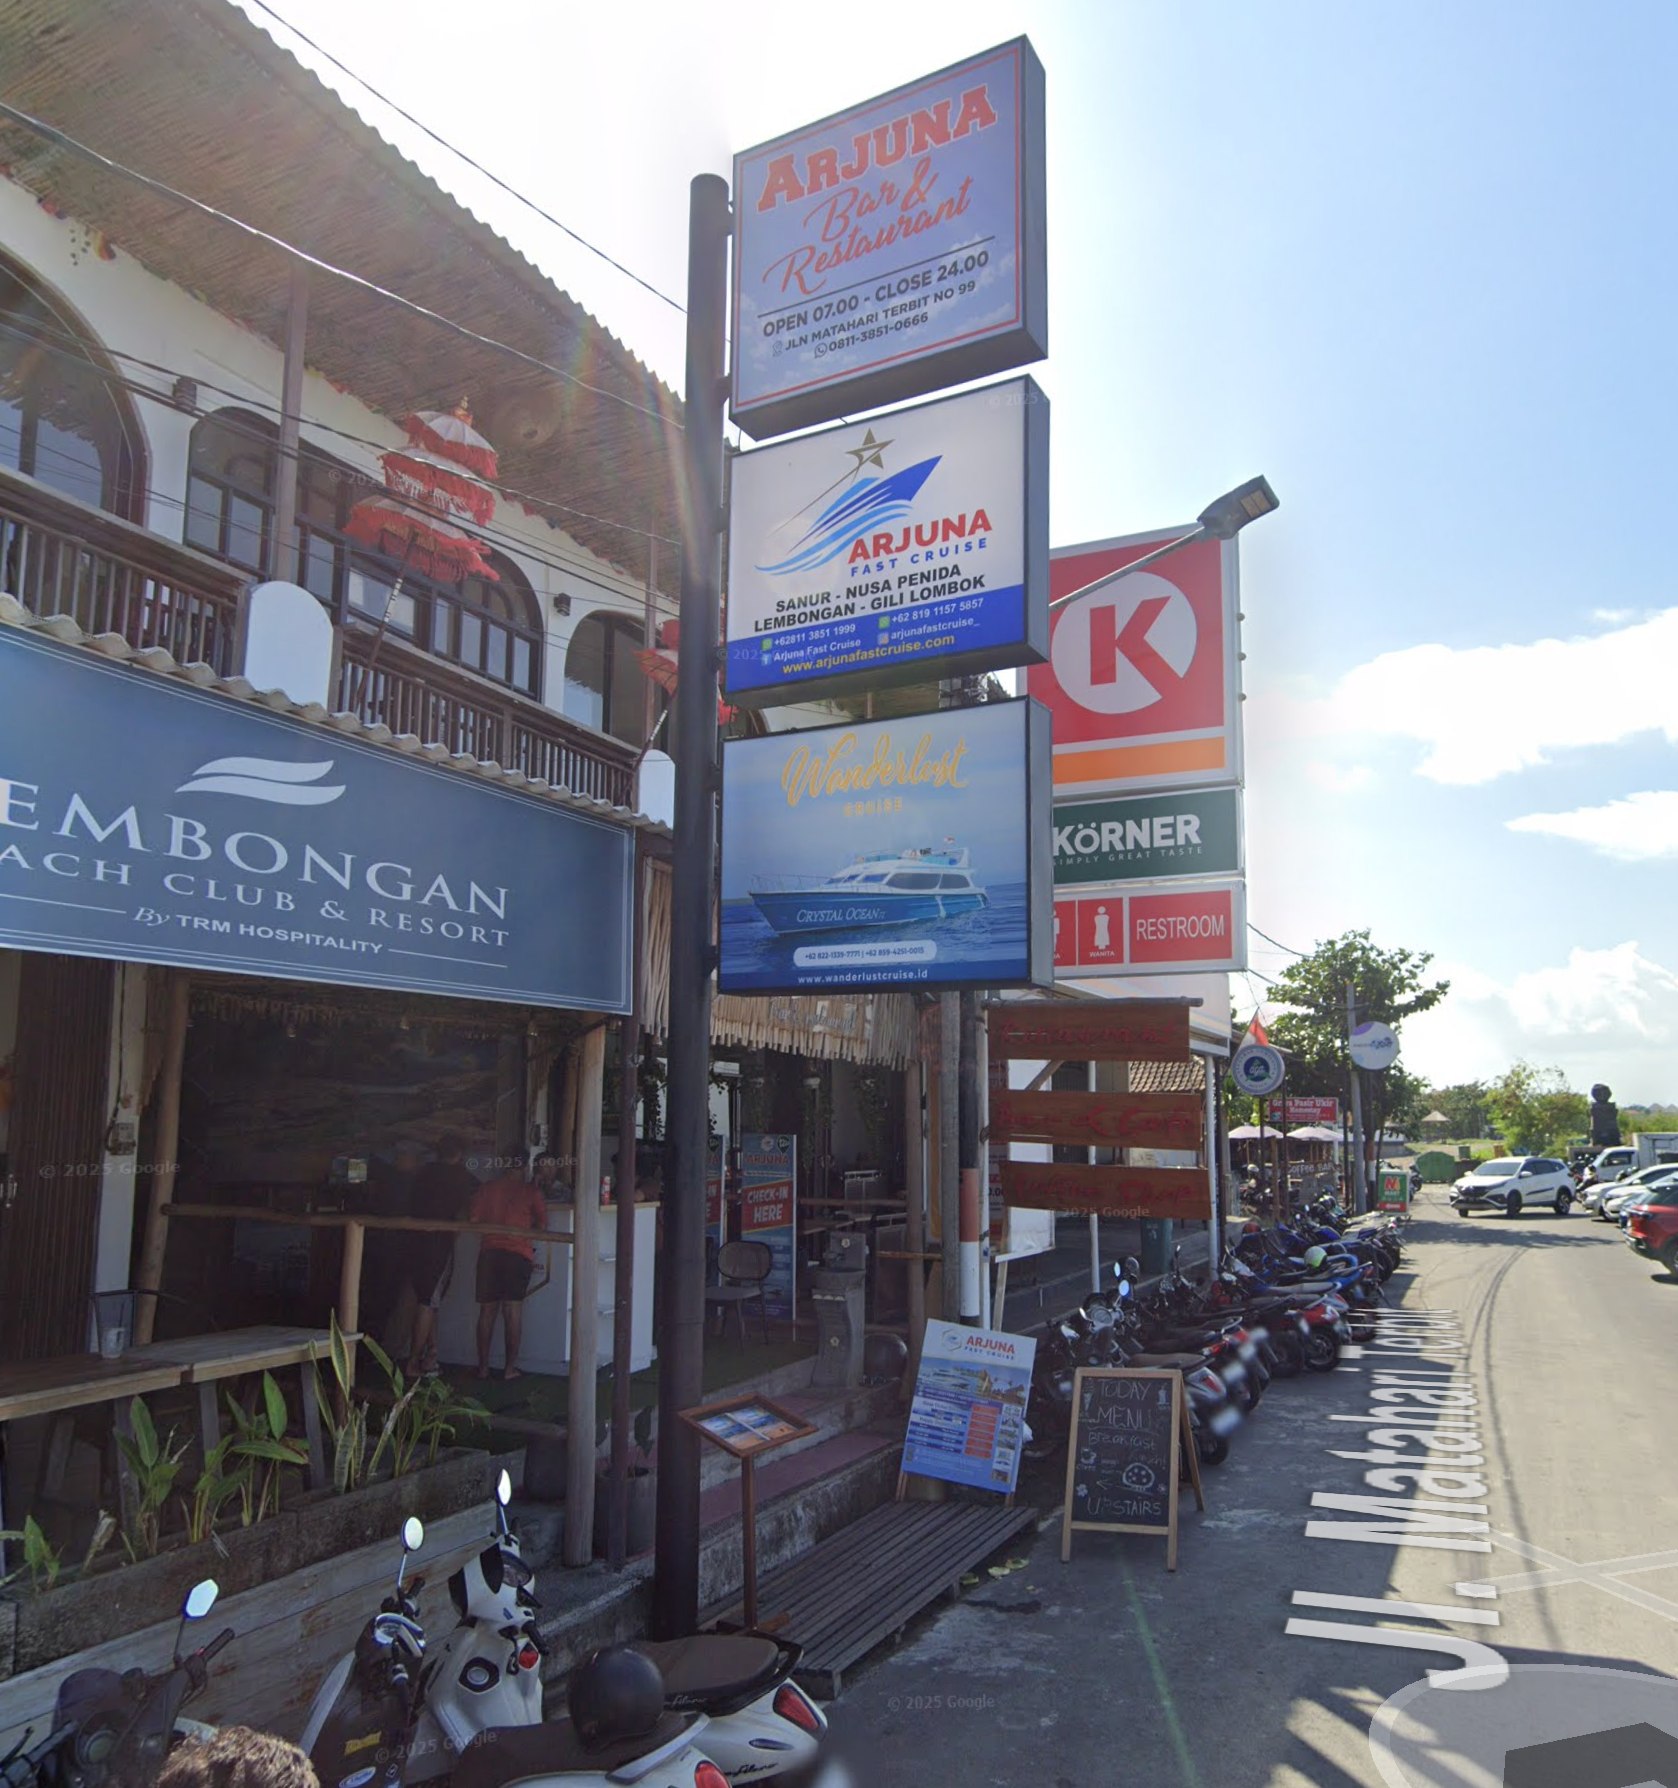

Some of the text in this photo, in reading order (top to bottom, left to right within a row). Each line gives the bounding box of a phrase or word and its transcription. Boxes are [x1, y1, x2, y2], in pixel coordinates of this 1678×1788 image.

[757, 84, 997, 213] ARJUNA
[803, 156, 939, 242] Bar &
[762, 175, 974, 294] Restaurant
[763, 310, 808, 337] OPEN
[813, 294, 860, 322] 07.00
[875, 270, 933, 303] CLOSE
[936, 250, 990, 283] 24.00
[785, 280, 976, 351] JLN MATAHARI TERBIT NO 99
[828, 313, 929, 353] 0811-3851-0666
[848, 508, 992, 565] ARJUNA
[850, 537, 987, 578] FAST CRUISE
[754, 603, 855, 633] LEMBONGAN
[871, 593, 903, 611] GILI
[910, 574, 985, 603] LOMBOK
[775, 590, 831, 613] SANUR
[846, 579, 892, 600] NUSA
[897, 564, 961, 589] PENIDA
[892, 598, 984, 623] +62 819 1157 5857
[774, 624, 856, 647] +62811 3851 1999
[774, 638, 861, 663] Arjuna Fast Cruise
[782, 633, 955, 675] www.arjunafastcruise.com
[1090, 596, 1183, 699] K
[782, 732, 968, 806] Wanderlust
[1053, 813, 1202, 857] KÖRNER
[1108, 851, 1151, 862] GREAT
[1161, 846, 1203, 858] TASTE
[163, 872, 297, 913] CLUB
[320, 900, 349, 922] &
[368, 907, 510, 947] RESORT
[796, 909, 843, 923] CRYSTAL
[845, 907, 880, 920] OCEAN
[1136, 915, 1225, 941] RESTROOM
[133, 906, 384, 955] By TRM HOSPITALITY
[1089, 950, 1115, 958] WANITA
[798, 969, 928, 984] www.wanderlustcruise.id
[747, 1186, 789, 1204] CHECK-IN
[753, 1203, 784, 1223] HERE
[966, 1335, 1015, 1354] ARJUNA
[1098, 1378, 1151, 1400] TODAY
